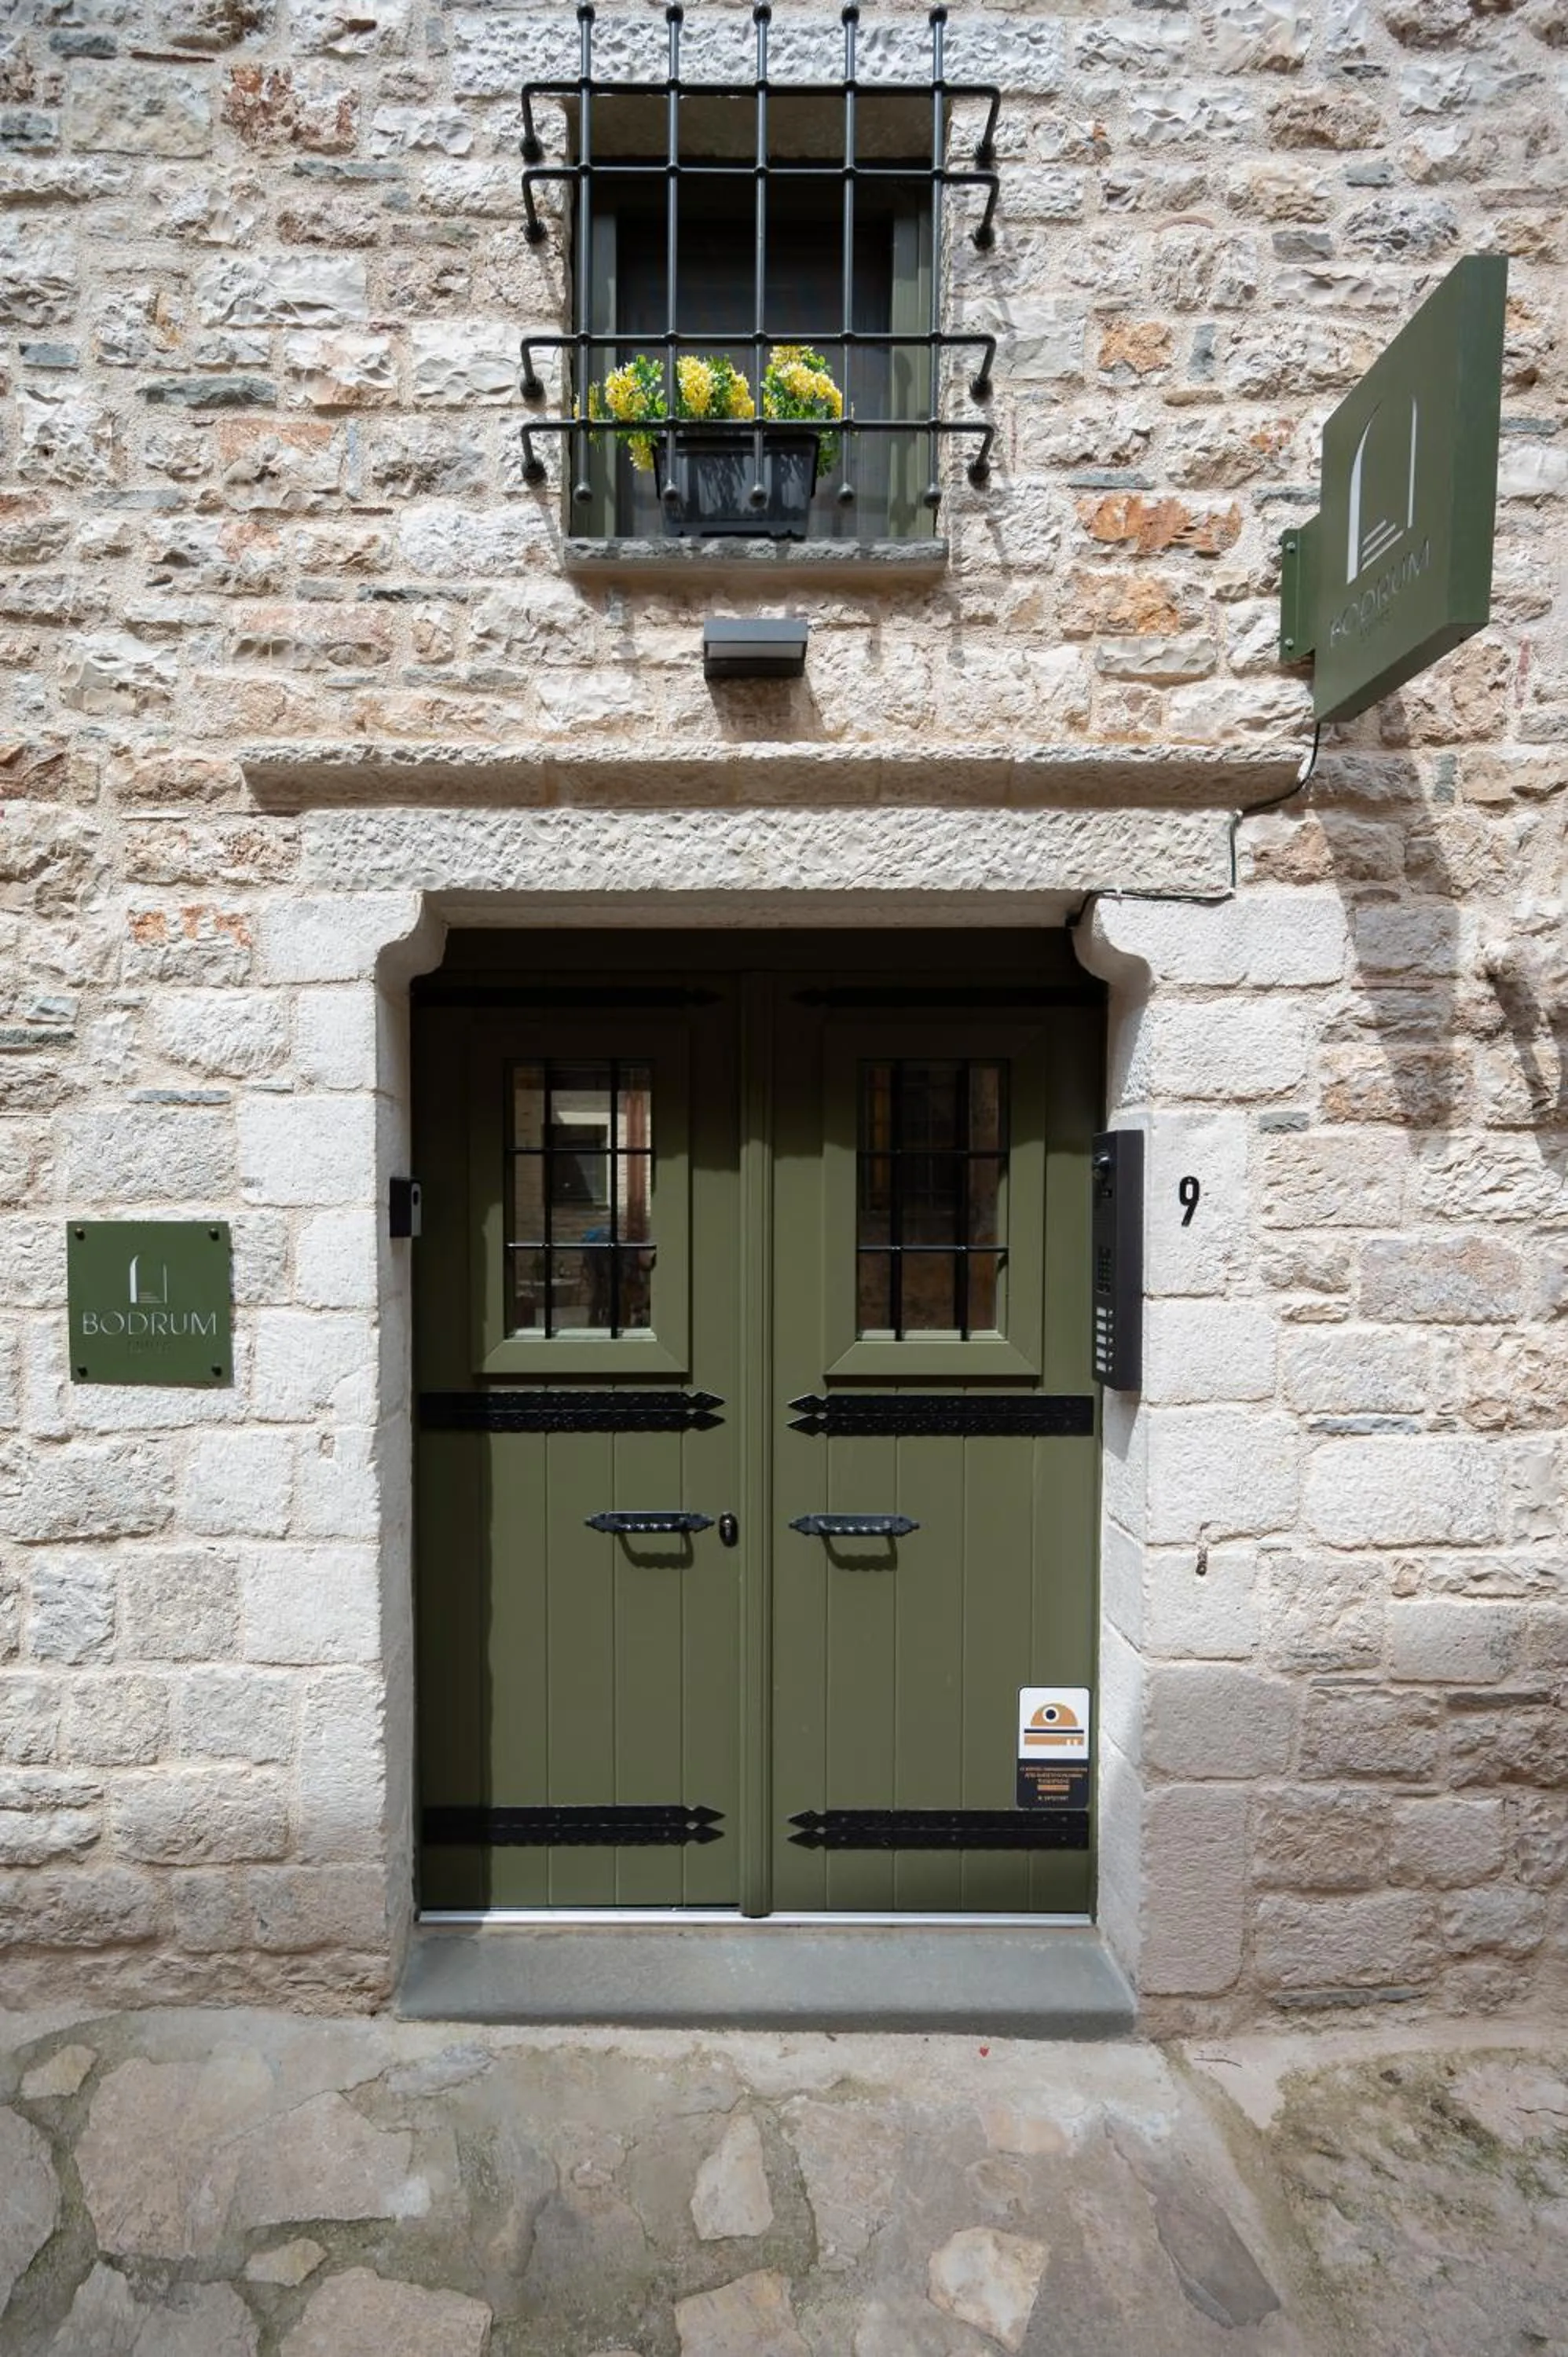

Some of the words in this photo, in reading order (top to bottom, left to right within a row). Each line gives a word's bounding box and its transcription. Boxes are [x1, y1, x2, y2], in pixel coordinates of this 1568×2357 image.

[1330, 538, 1430, 648] BODRUM
[1179, 1175, 1200, 1227] 9
[82, 1311, 217, 1336] BODRUM
